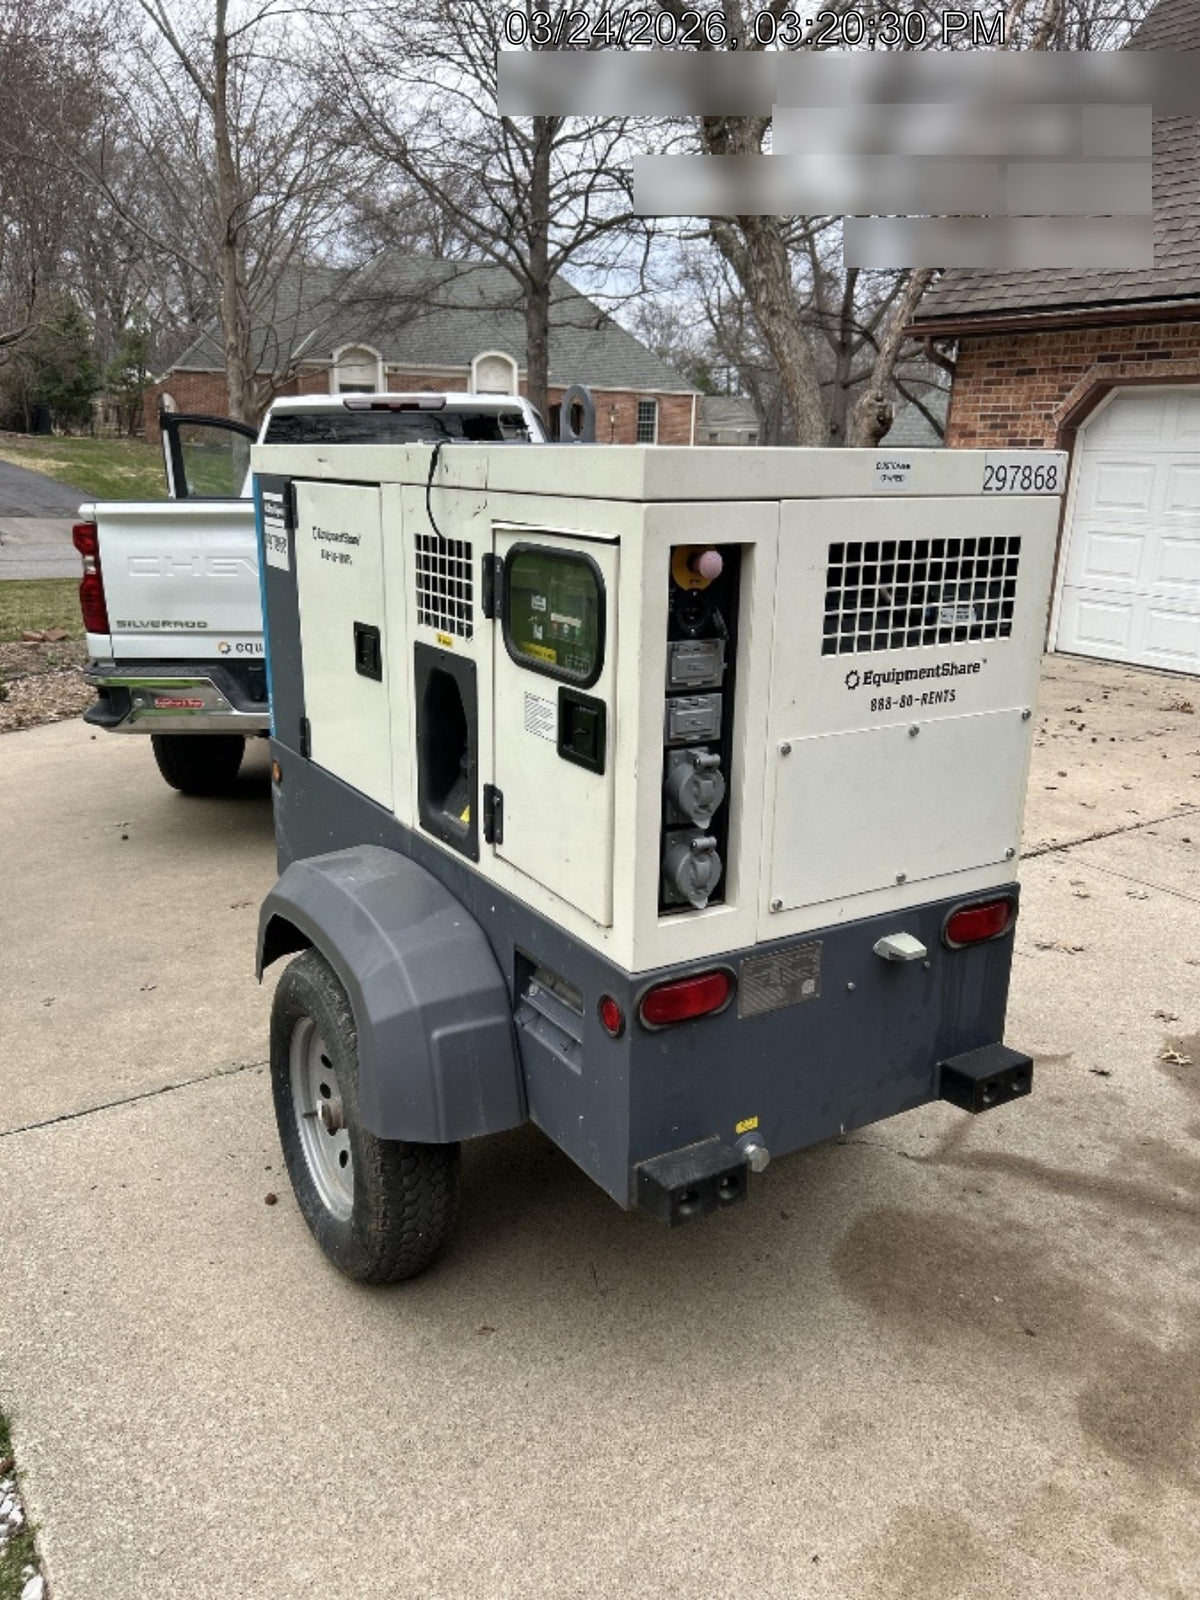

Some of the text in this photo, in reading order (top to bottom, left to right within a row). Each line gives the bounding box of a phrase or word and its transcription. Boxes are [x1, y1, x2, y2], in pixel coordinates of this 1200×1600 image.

[983, 465, 1057, 491] 297868
[116, 620, 208, 629] SILVERADO
[862, 662, 981, 687] EquipmentShare
[870, 689, 956, 712] 888-80-RENTS
